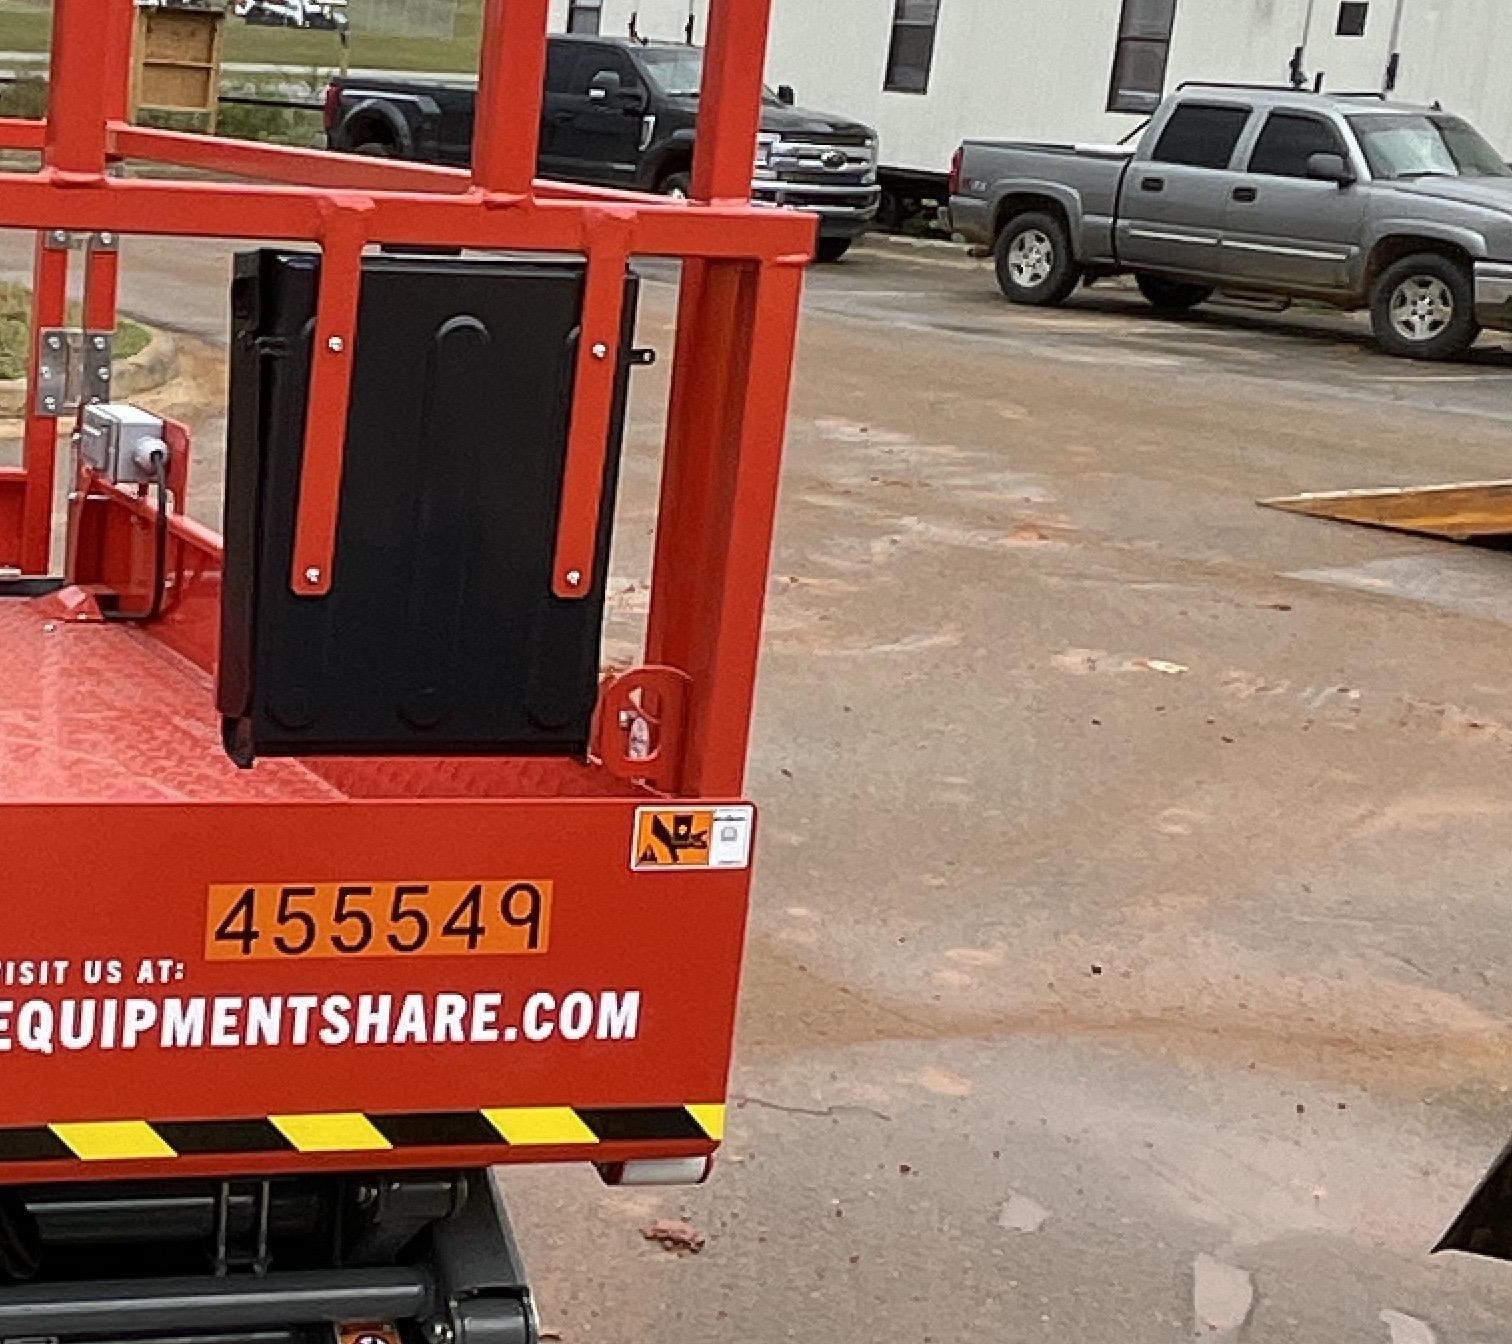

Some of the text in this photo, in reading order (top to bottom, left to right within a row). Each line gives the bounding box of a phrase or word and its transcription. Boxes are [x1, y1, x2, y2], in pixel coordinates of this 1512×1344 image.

[214, 881, 544, 956] 455549
[84, 959, 123, 985] US
[136, 959, 186, 985] AT:
